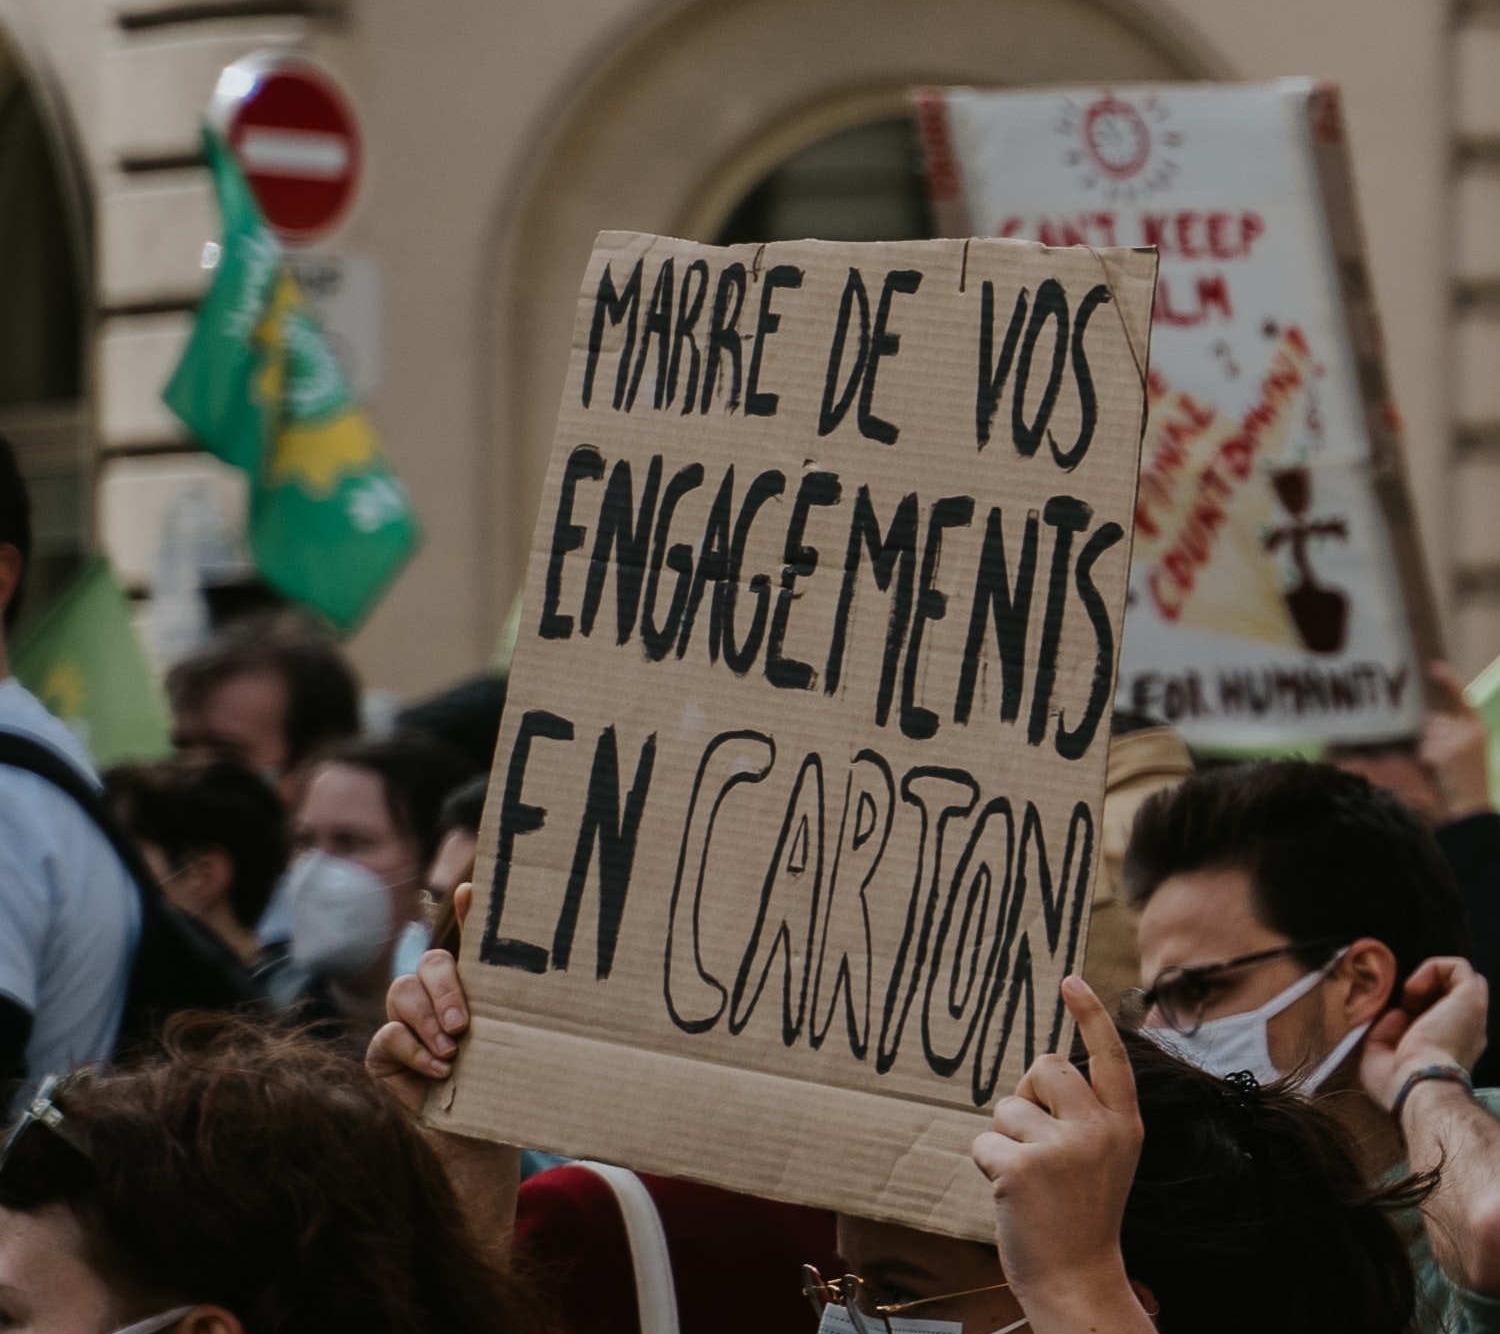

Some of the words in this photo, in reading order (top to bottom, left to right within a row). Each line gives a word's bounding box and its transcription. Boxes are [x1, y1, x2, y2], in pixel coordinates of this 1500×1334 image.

[1142, 208, 1265, 260] KEEP
[1153, 269, 1234, 331] LM
[581, 258, 804, 418] MARRE
[818, 267, 921, 444] DE
[976, 278, 1112, 471] VOS
[539, 445, 1124, 760] ENGAGEMENTS
[1219, 662, 1408, 715] HUMANITY
[479, 709, 658, 980] EN
[664, 730, 1093, 1106] CARTON
